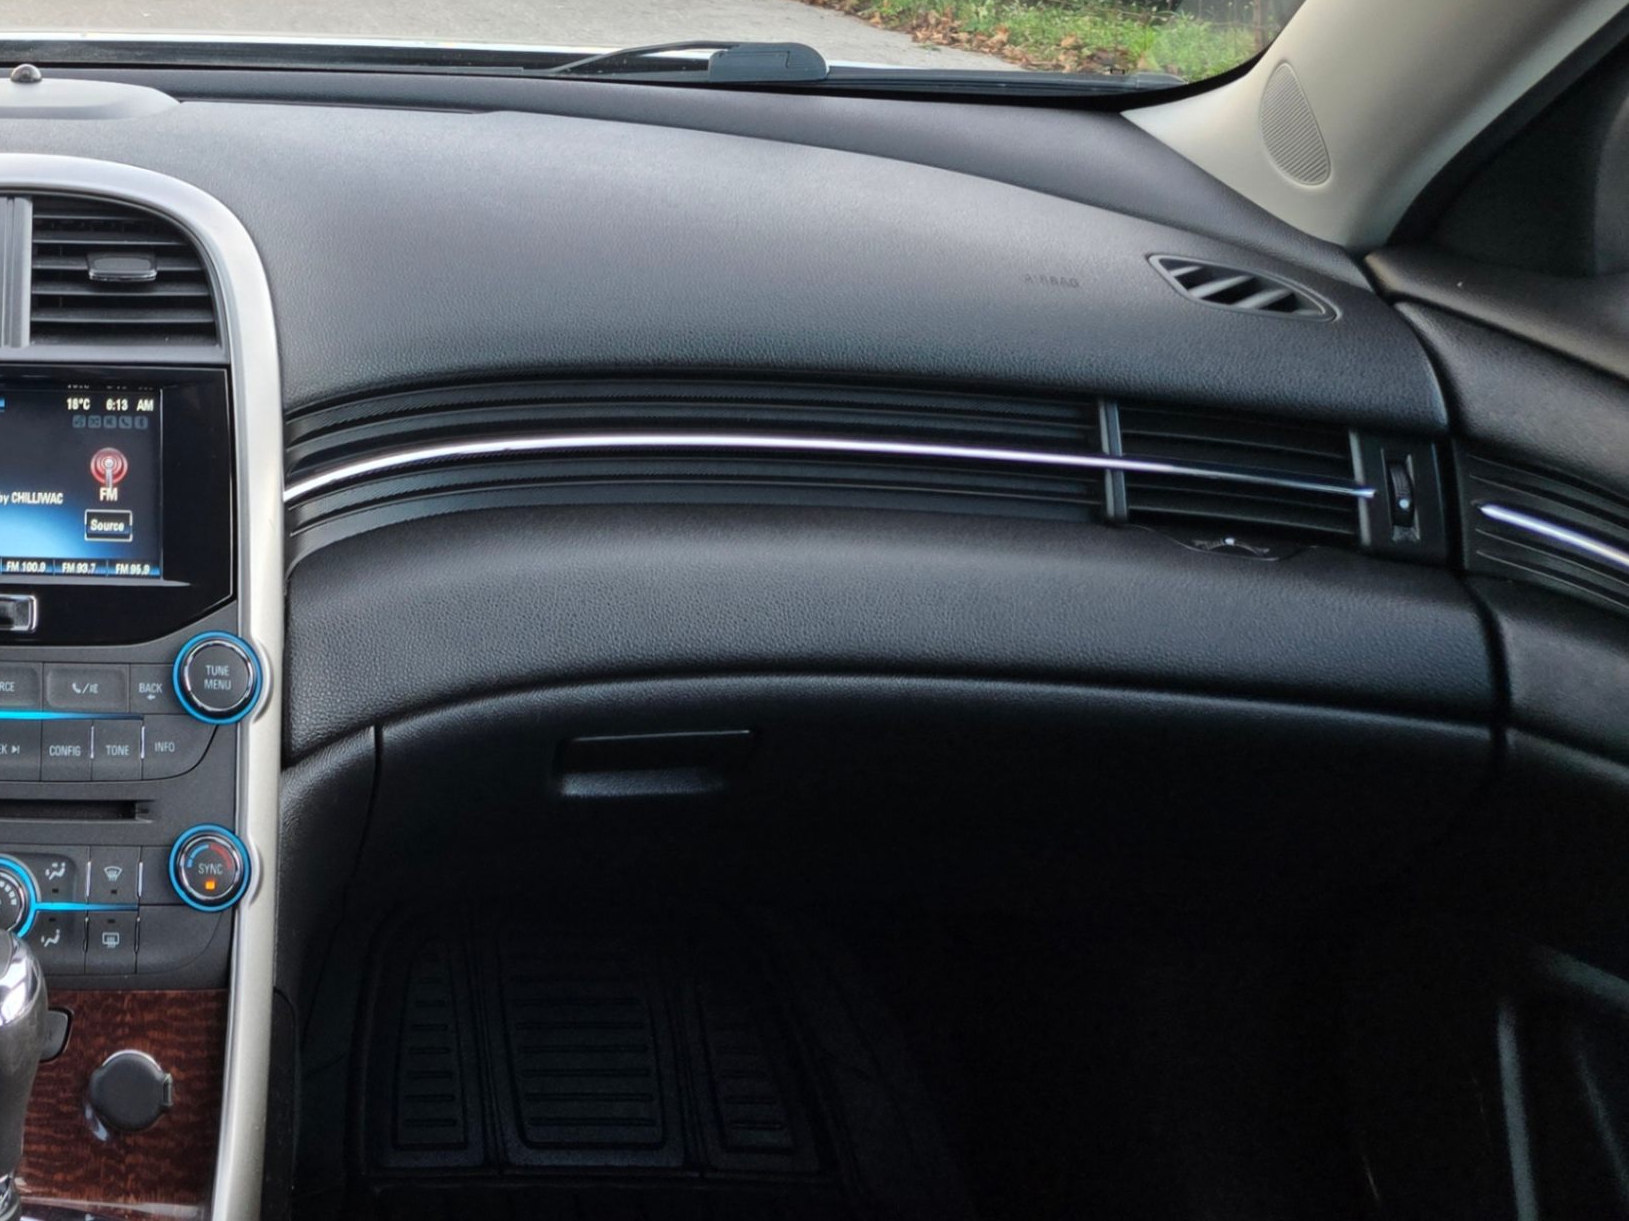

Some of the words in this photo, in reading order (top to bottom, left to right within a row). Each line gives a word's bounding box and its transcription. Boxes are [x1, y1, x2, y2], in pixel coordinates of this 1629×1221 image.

[136, 399, 154, 411] AM
[99, 487, 118, 501] FM
[90, 519, 125, 532] Source
[6, 561, 20, 572] FM
[62, 562, 76, 573] FM
[116, 563, 129, 575] FM
[205, 665, 230, 676] TUNE
[138, 682, 163, 693] BACK
[204, 679, 231, 691] MENU
[49, 745, 81, 757] CONFIG
[105, 744, 130, 756] TONE
[154, 741, 175, 753] INFO
[198, 863, 223, 875] SYNC
